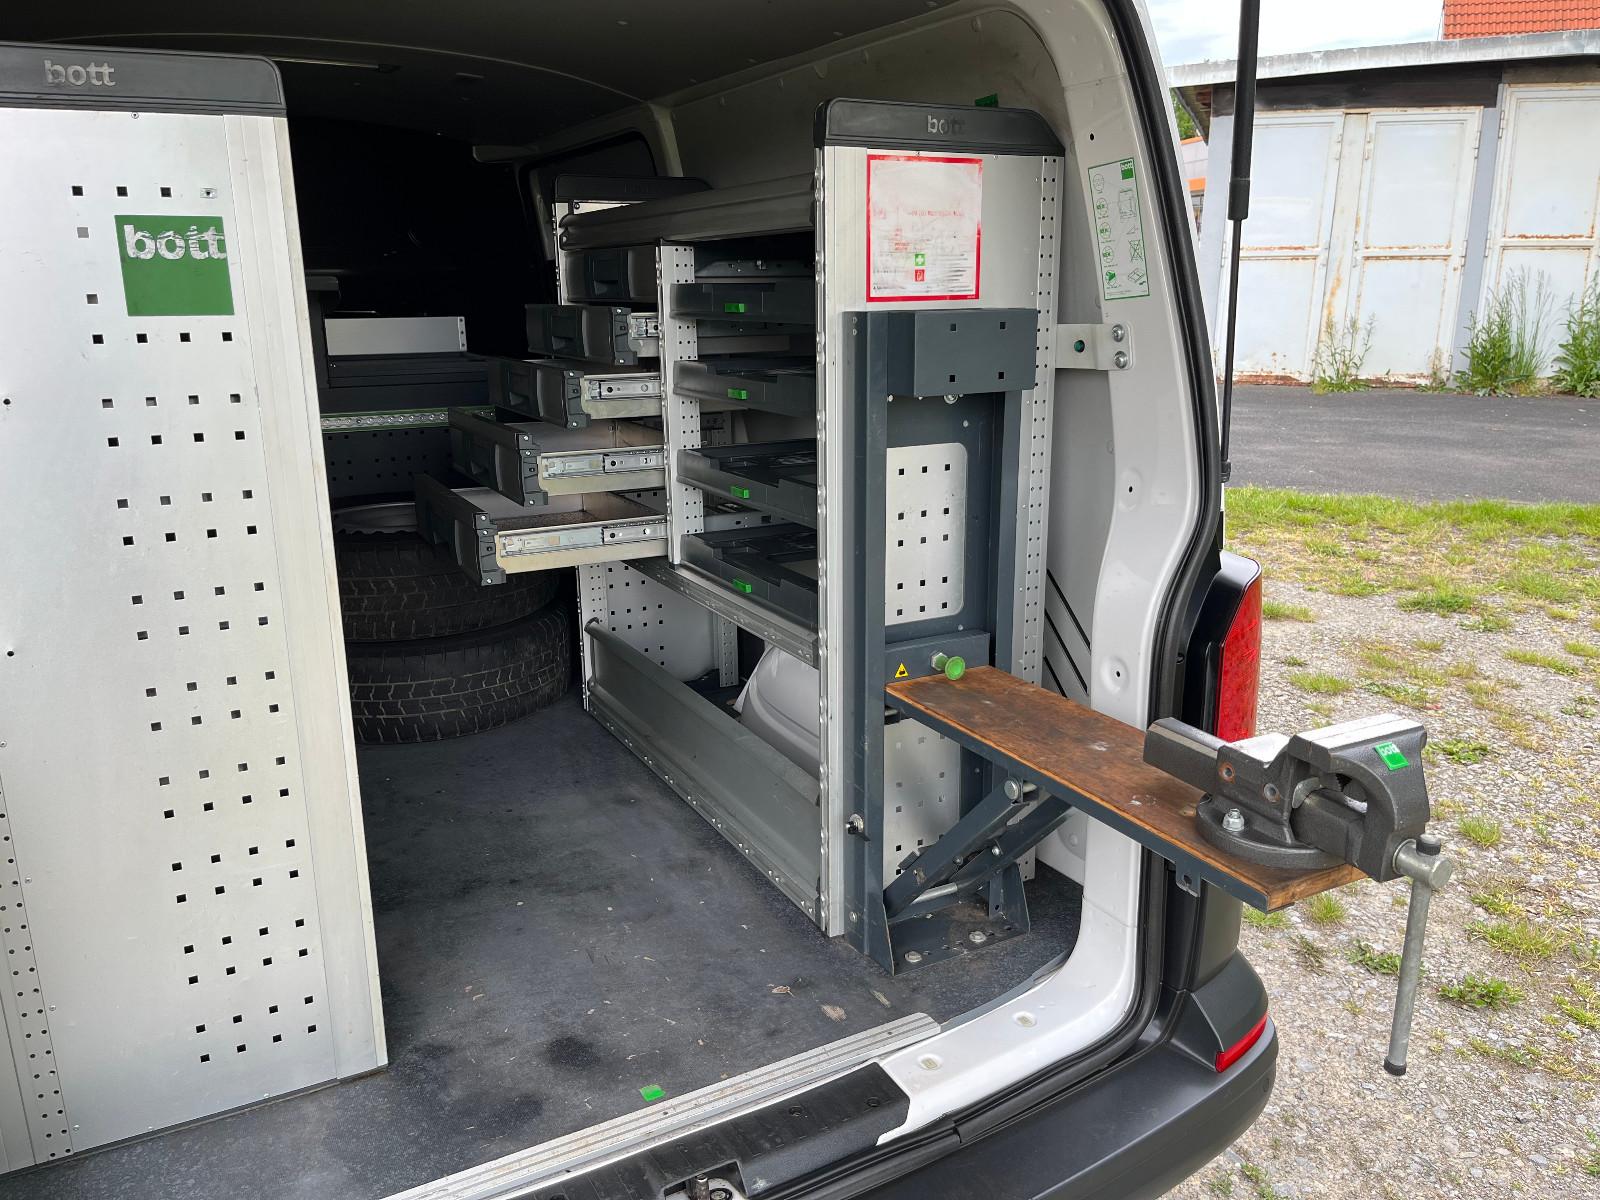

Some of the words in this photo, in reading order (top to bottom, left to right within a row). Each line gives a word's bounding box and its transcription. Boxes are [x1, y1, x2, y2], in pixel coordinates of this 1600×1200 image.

[44, 59, 116, 87] bott
[1120, 160, 1134, 171] bott
[124, 224, 227, 260] bott
[1376, 741, 1401, 756] bott
